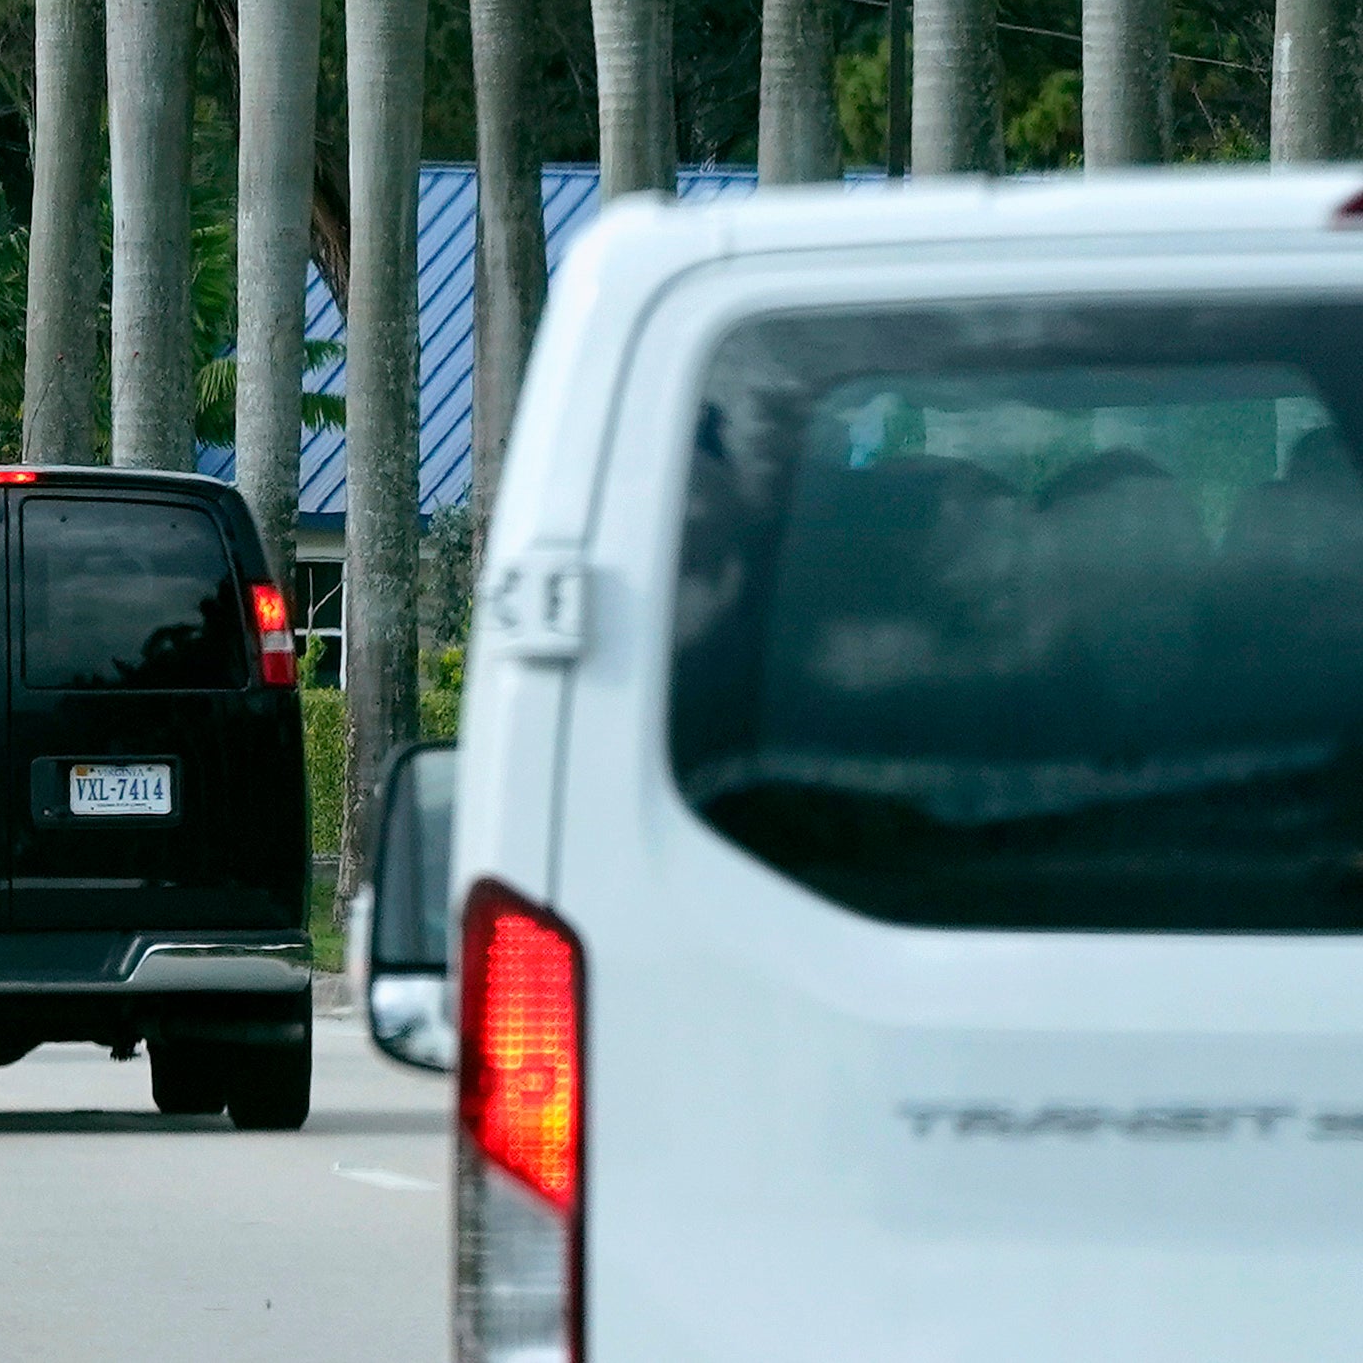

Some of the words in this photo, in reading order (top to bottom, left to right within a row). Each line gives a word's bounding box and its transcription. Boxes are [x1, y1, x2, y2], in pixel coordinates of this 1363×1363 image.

[97, 768, 144, 777] VIRGINIA
[75, 778, 163, 801] VXL-7414
[896, 1098, 1297, 1141] TRANSIT
